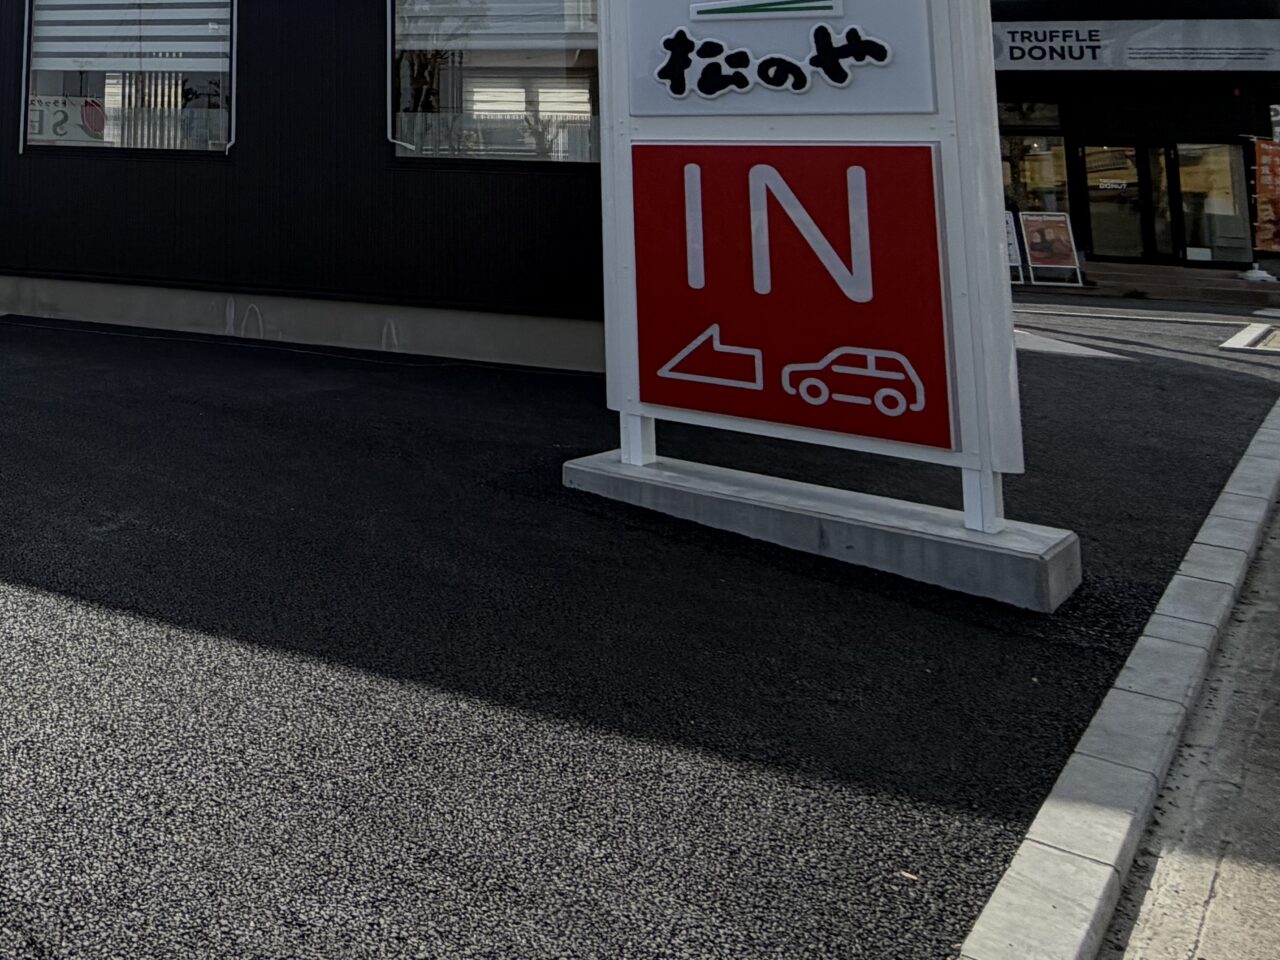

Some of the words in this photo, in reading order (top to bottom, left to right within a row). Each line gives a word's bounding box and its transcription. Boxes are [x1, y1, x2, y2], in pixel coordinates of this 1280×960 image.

[1007, 29, 1101, 43] TRUFFLE
[1008, 45, 1102, 61] DONUT
[654, 21, 894, 101] 松のや
[683, 162, 874, 304] IN
